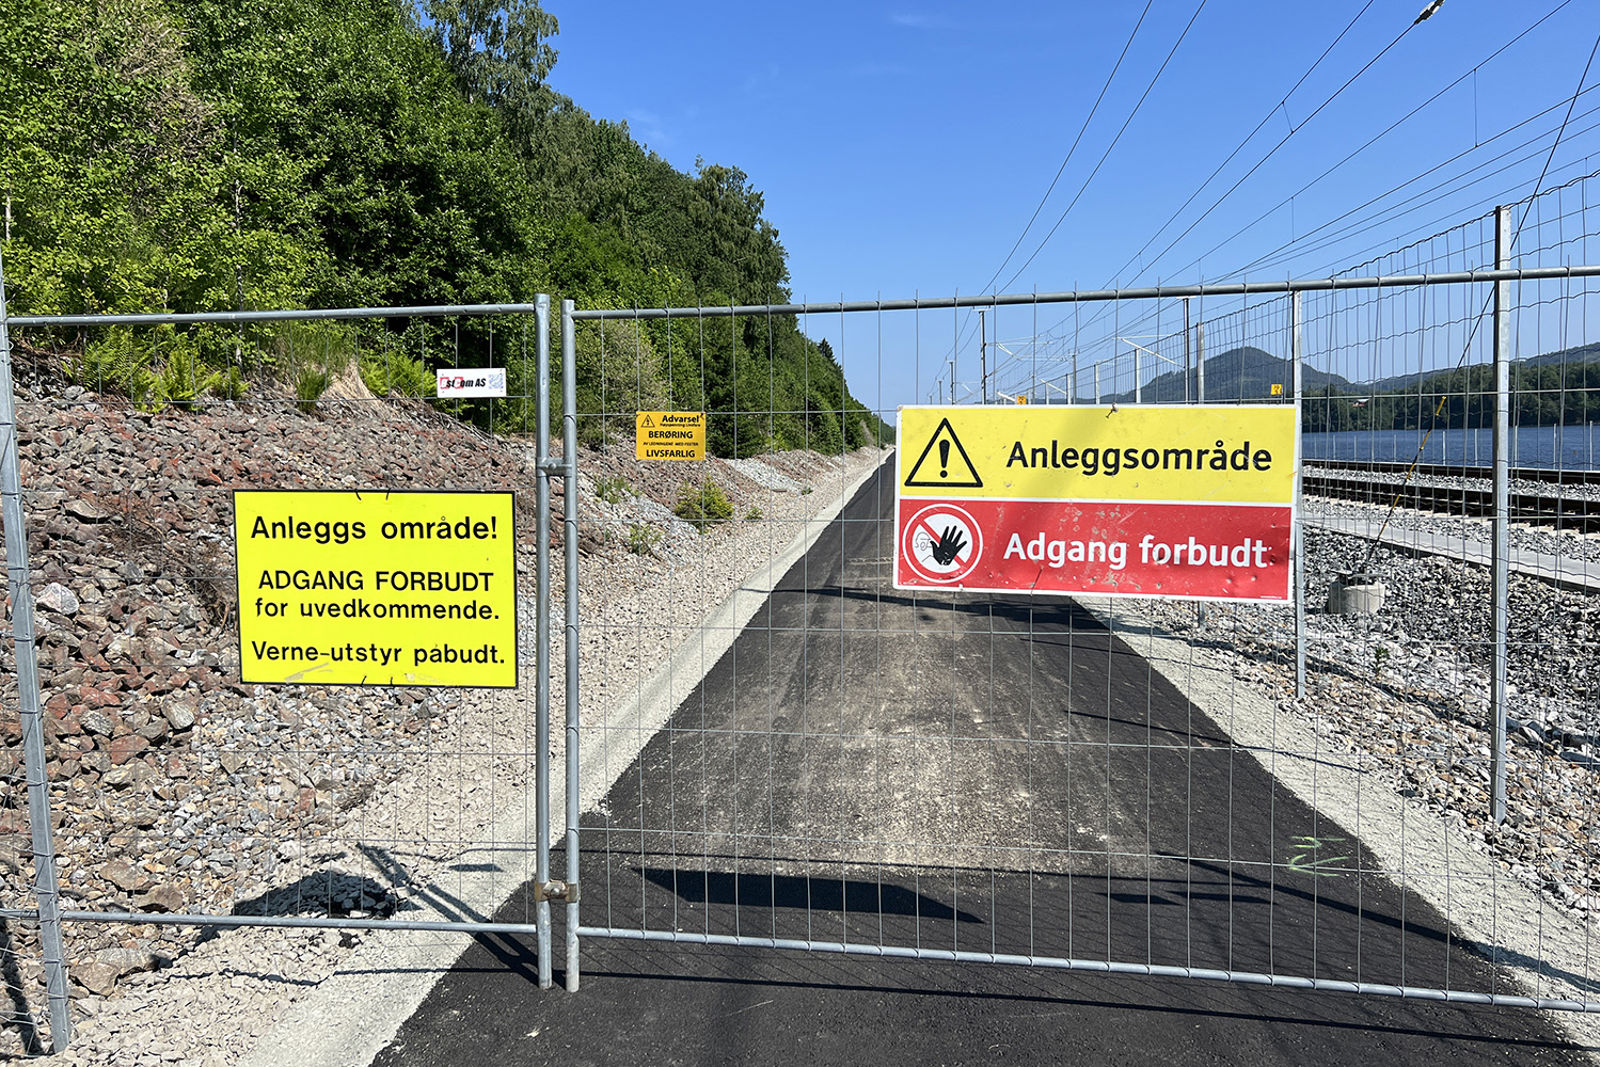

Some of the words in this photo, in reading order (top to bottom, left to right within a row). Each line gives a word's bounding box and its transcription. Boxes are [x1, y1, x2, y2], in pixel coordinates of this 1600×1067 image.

[475, 378, 486, 387] AS
[662, 415, 699, 423] Advarsel
[648, 430, 693, 439] BERØRING
[646, 449, 695, 458] LIVSFARLIG
[1006, 440, 1272, 476] Anleggsområde
[251, 515, 366, 544] Anleggs
[381, 515, 497, 539] område!
[1003, 532, 1127, 571] Adgang
[1139, 534, 1268, 568] forbudt
[258, 570, 364, 590] ADGANG
[376, 571, 494, 592] FORBUDT
[255, 597, 288, 617] for
[300, 598, 499, 620] uvedkommende.
[251, 640, 402, 666] Verne-utstyr
